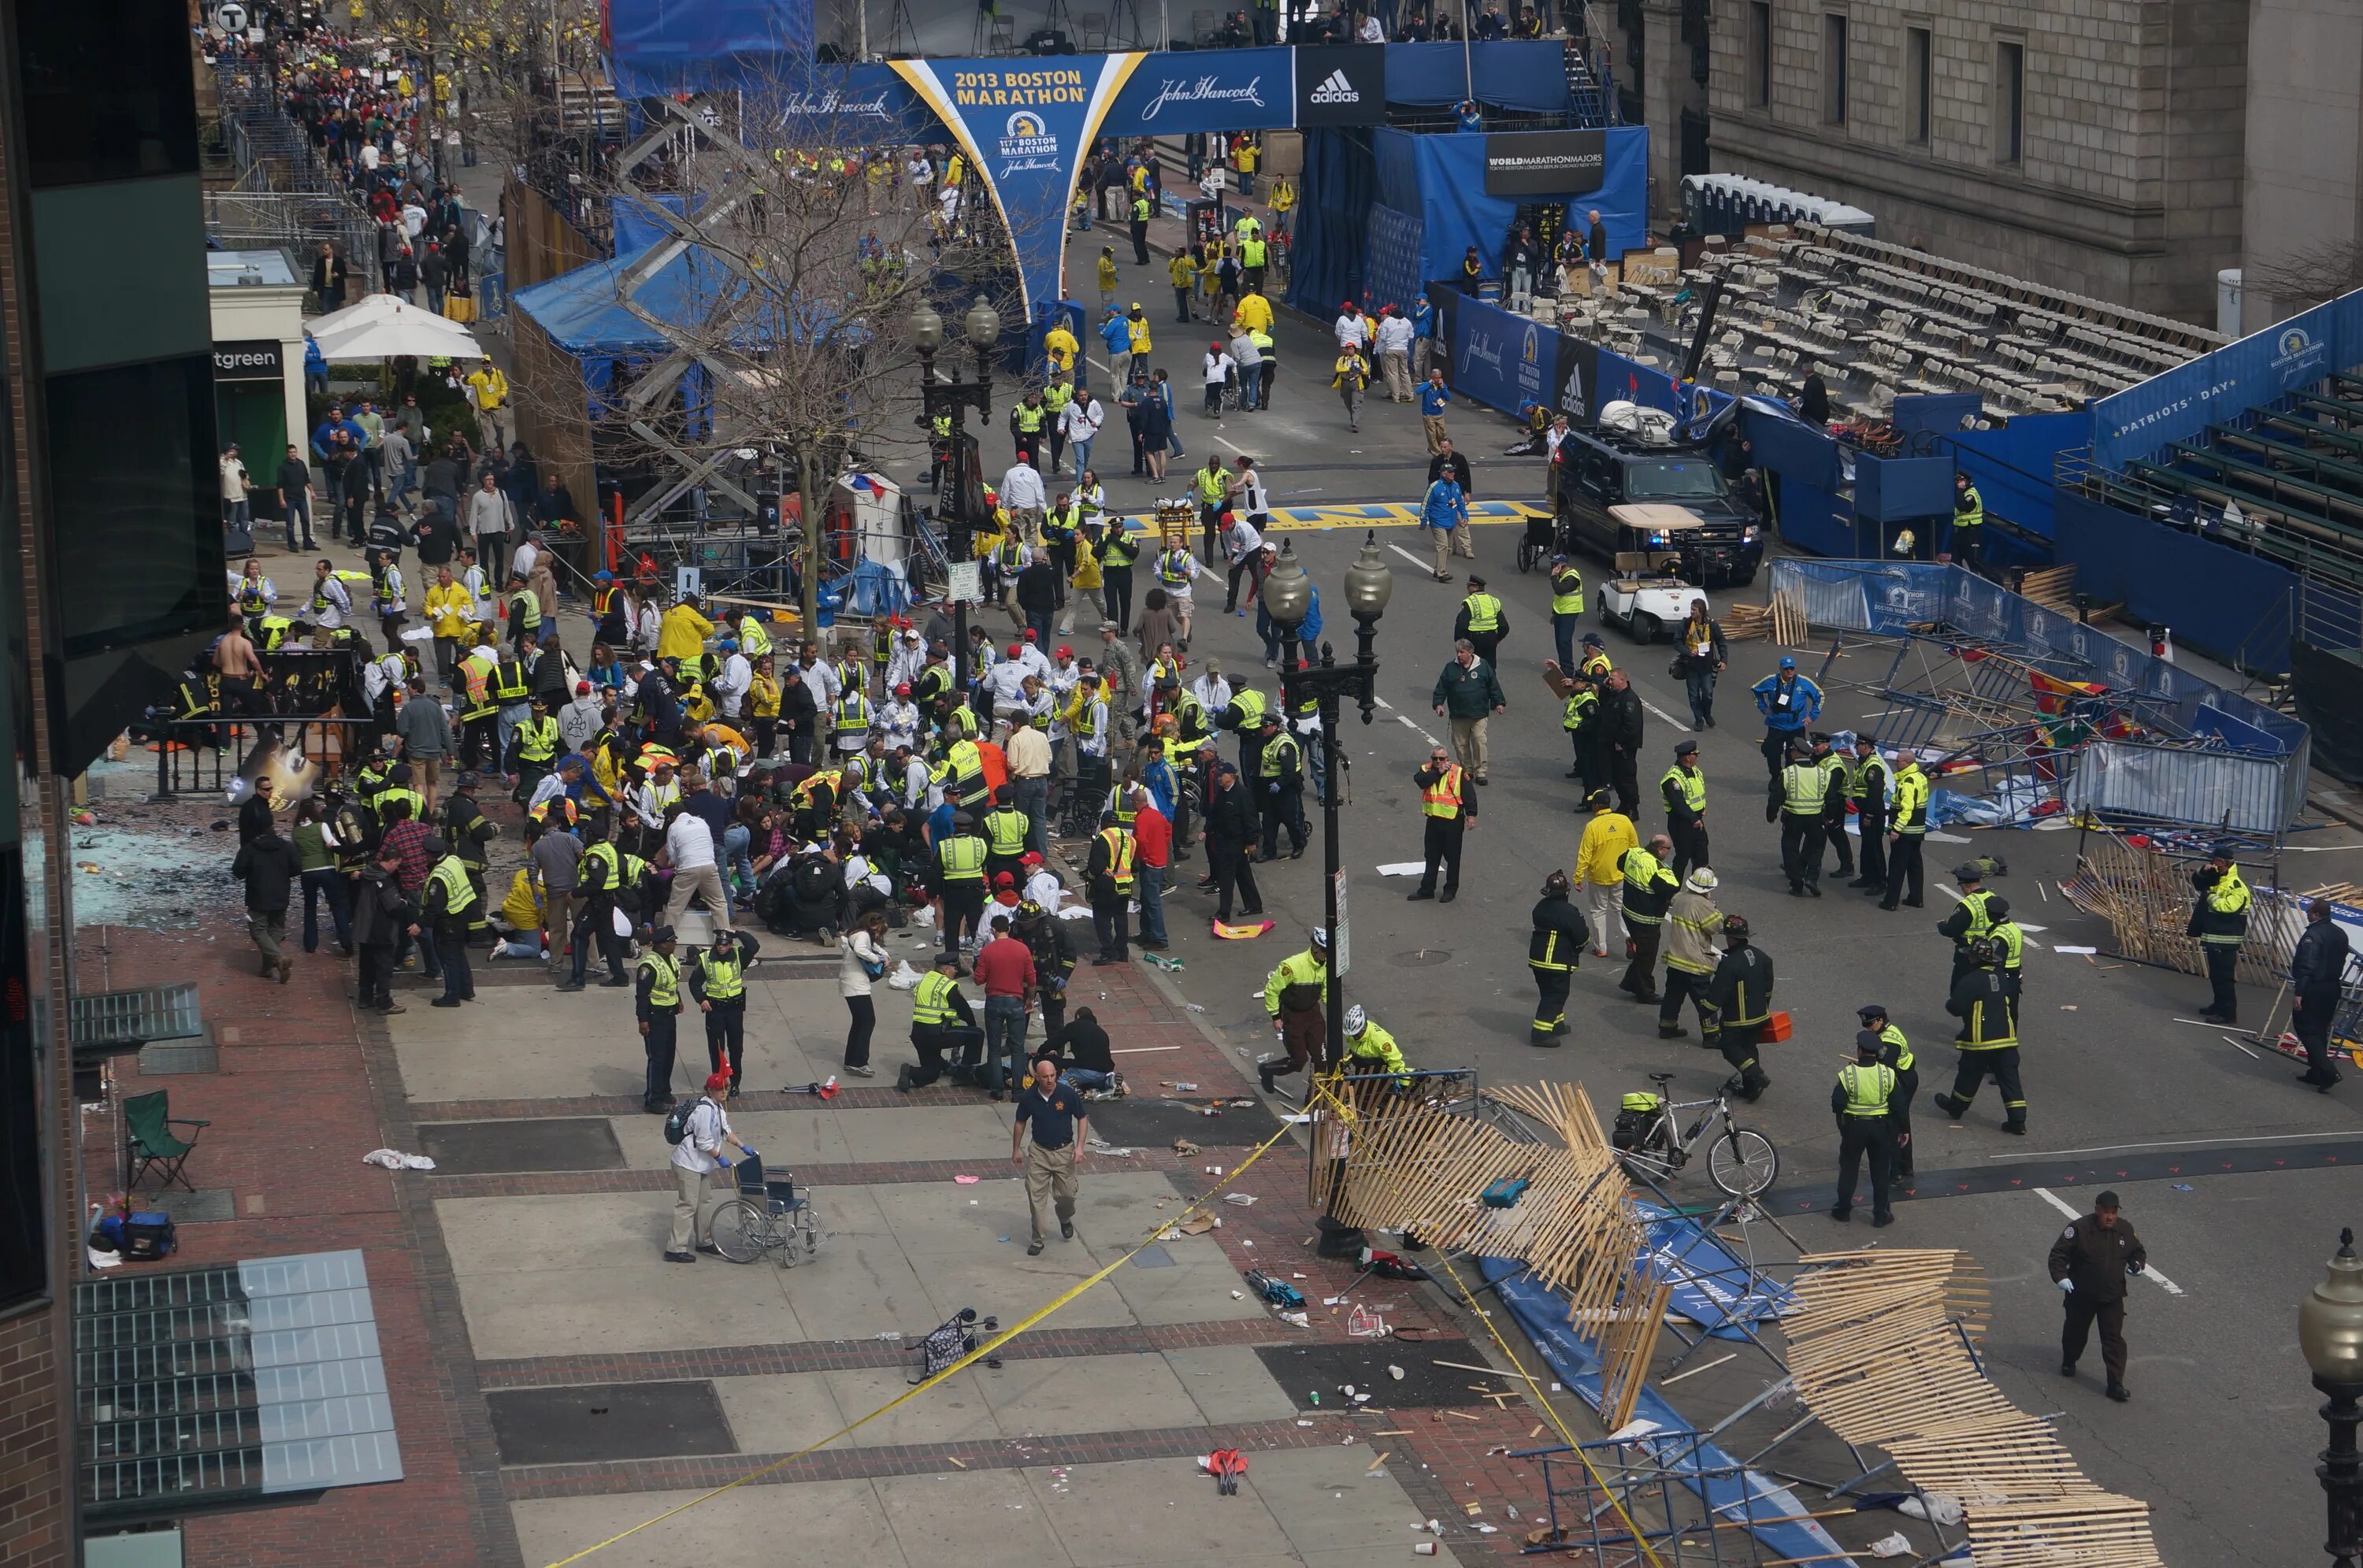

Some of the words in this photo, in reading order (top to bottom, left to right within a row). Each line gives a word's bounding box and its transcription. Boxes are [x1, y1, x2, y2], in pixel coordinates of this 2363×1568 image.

[221, 10, 243, 28] T
[955, 72, 998, 87] 2013
[1005, 70, 1081, 87] BOSTON
[956, 87, 1085, 105] MARATHON
[1141, 79, 1190, 120] John
[1190, 75, 1265, 107] Hancock
[1310, 89, 1360, 103] adidas
[769, 91, 818, 133] John
[817, 89, 892, 122] Hancock
[1000, 144, 1057, 156] MARATHON
[1018, 136, 1056, 146] BOSTON
[1000, 159, 1024, 180] John
[1023, 157, 1062, 172] Hancock
[1489, 154, 1602, 166] WORLDMARATHONMAJORS
[213, 352, 276, 369] tgreen
[1462, 328, 1481, 373] John
[1480, 332, 1504, 381] Hancock
[2270, 354, 2293, 368] BOSTON
[2293, 342, 2324, 358] MARATHON
[1525, 363, 1541, 379] BOSTON
[2280, 365, 2298, 385] John
[1519, 373, 1540, 391] MARATHON
[2201, 381, 2228, 400] DAY
[1561, 395, 1585, 417] adidas
[940, 482, 951, 510] 2013
[768, 508, 775, 519] P
[951, 565, 958, 574] 2
[1874, 603, 1894, 613] BOSTON
[957, 751, 977, 765] Boston
